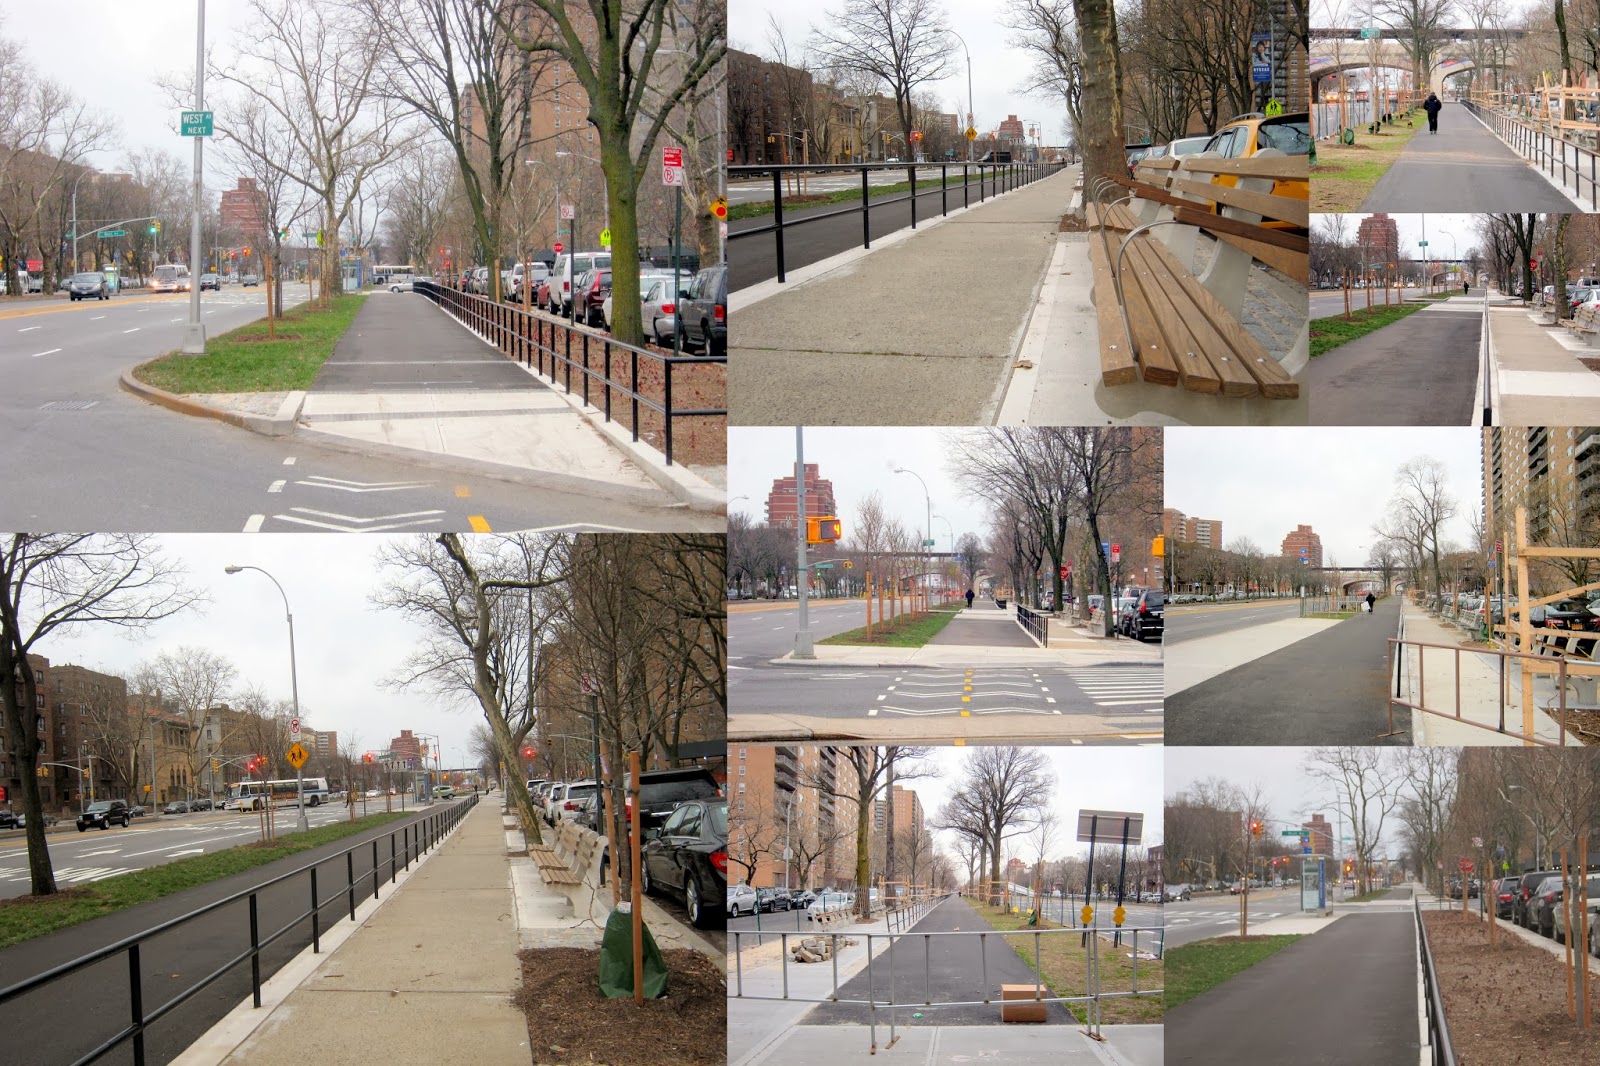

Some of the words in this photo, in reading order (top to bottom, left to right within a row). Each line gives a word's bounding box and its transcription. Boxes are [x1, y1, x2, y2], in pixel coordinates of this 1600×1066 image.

[182, 113, 204, 124] WEST
[187, 126, 207, 134] NEXT
[833, 524, 840, 536] 4
